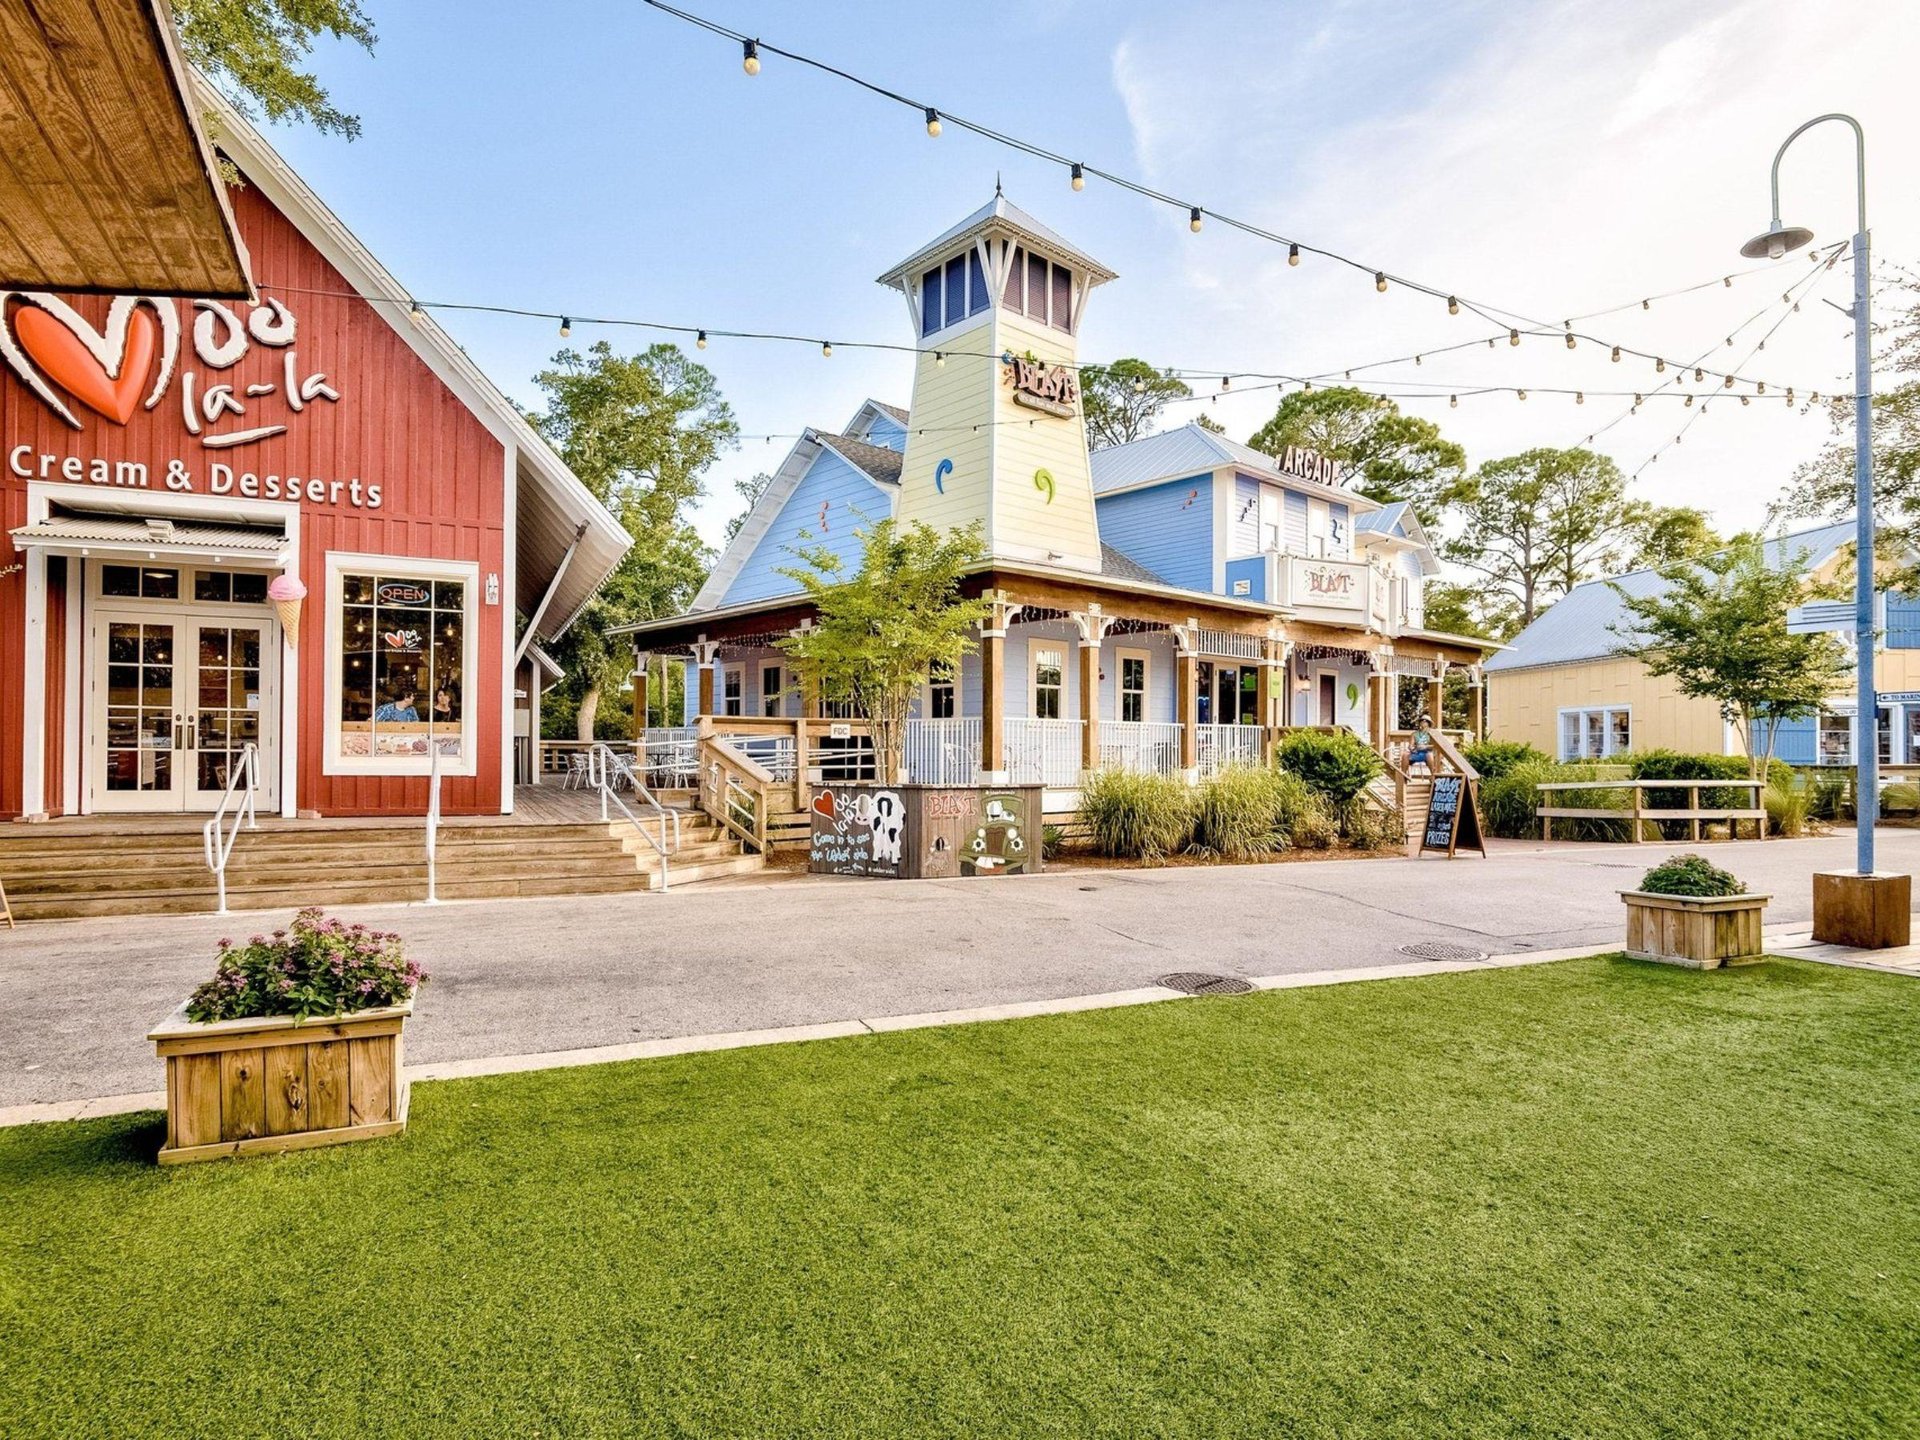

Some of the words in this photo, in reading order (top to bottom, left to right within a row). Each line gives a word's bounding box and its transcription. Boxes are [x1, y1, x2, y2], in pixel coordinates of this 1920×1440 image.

[9, 445, 148, 488] Cream
[165, 459, 194, 492] &
[210, 463, 383, 508] Desserts
[381, 588, 424, 600] OPEN
[833, 727, 848, 735] FDC
